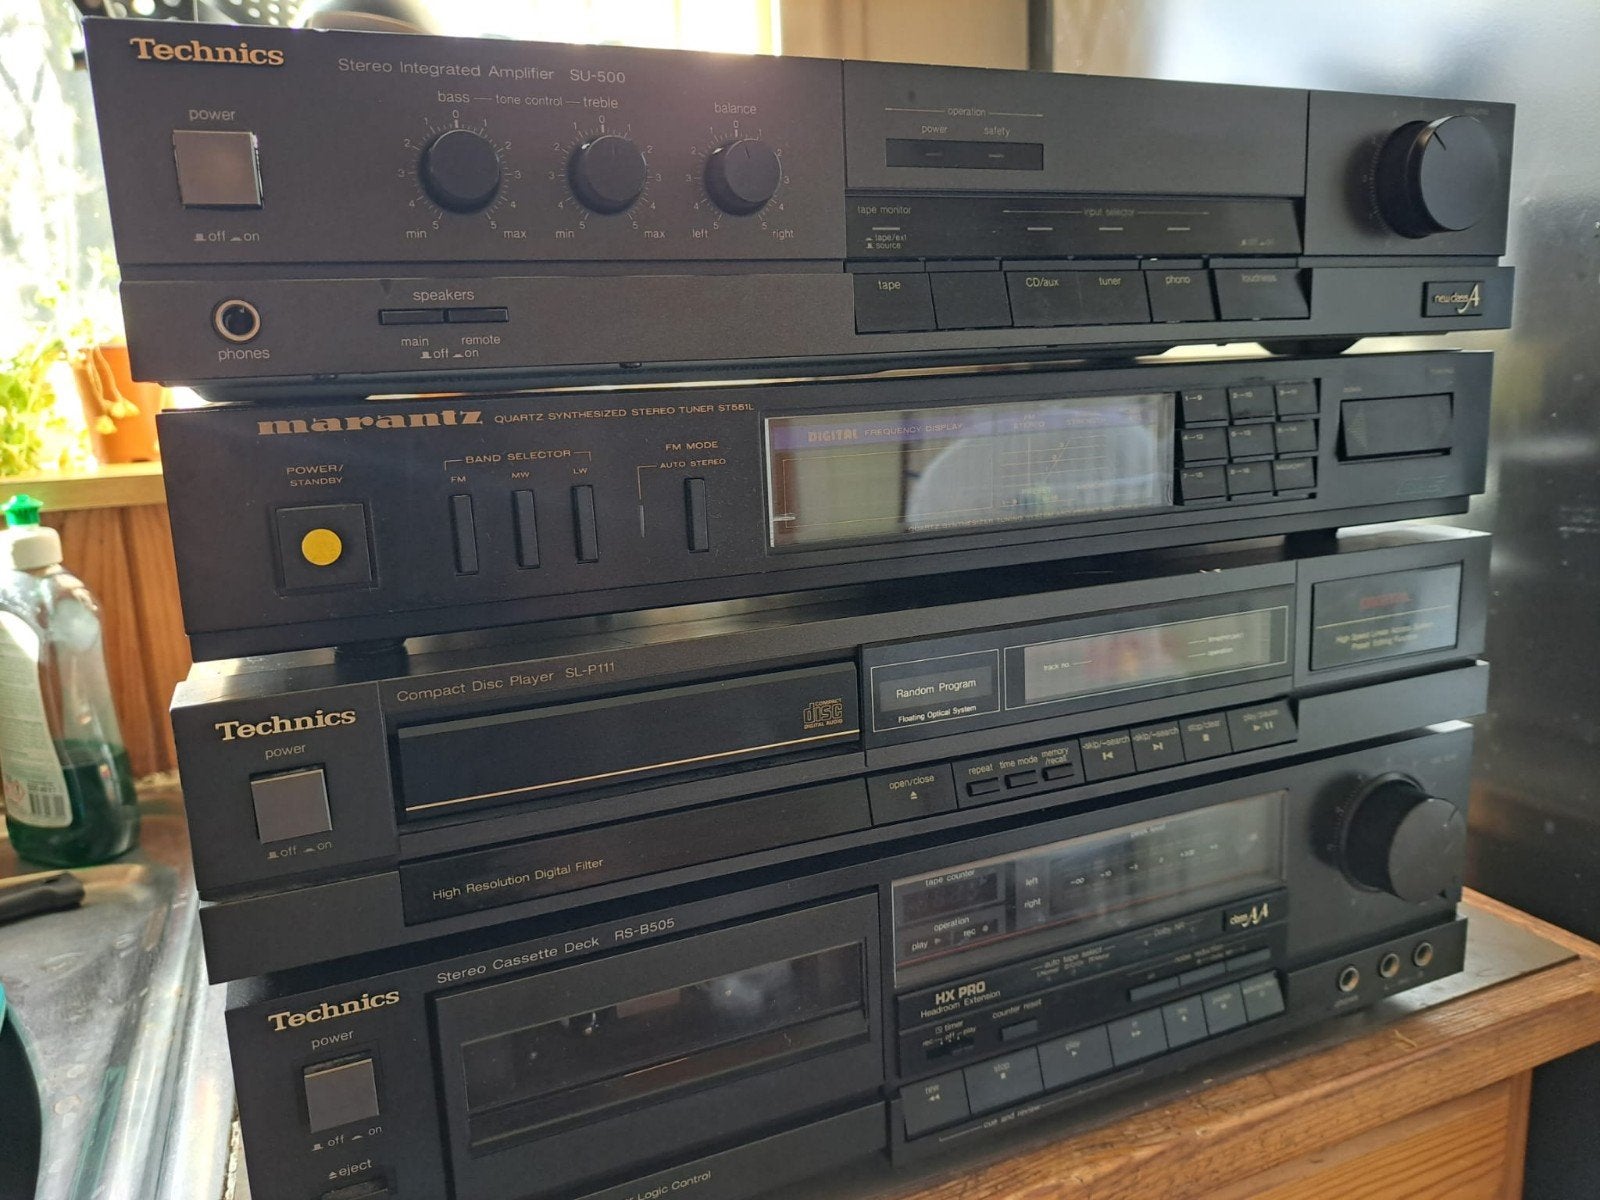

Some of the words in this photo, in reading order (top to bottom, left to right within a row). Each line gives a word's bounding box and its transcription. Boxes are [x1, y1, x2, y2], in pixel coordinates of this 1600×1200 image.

[130, 37, 285, 67] Technics
[338, 58, 393, 73] Stereo
[400, 61, 481, 78] Integrated
[489, 65, 554, 81] Amplifier
[570, 69, 626, 83] SU-500
[437, 90, 470, 104] bass
[496, 93, 521, 105] tone
[524, 95, 563, 107] control
[583, 96, 619, 109] treble
[714, 102, 757, 115] balance
[947, 107, 987, 118] operation
[188, 108, 236, 122] power
[921, 125, 949, 135] power
[984, 126, 1011, 137] safety
[857, 205, 877, 216] tape
[880, 205, 912, 215] monitor
[208, 230, 227, 242] off
[243, 231, 260, 242] on
[406, 228, 427, 239] min
[503, 229, 527, 239] max
[555, 229, 575, 239] min
[644, 230, 665, 239] max
[692, 229, 708, 239] left
[772, 229, 794, 240] right
[876, 241, 902, 249] source
[878, 280, 901, 291] tape
[1025, 277, 1060, 288] CD/aux
[1099, 276, 1121, 286] tuner
[1165, 275, 1191, 286] phono
[413, 289, 475, 302] speakers
[1457, 283, 1480, 314] A
[401, 336, 430, 347] main
[461, 334, 501, 346] remote
[218, 347, 270, 362] phones
[433, 349, 449, 359] off
[464, 349, 479, 358] on
[257, 409, 484, 436] marantz
[494, 413, 544, 424] QUARTZ
[548, 409, 627, 421] SYNTHESIZED
[631, 406, 675, 417] STEREO
[678, 404, 714, 414] TUNER
[808, 428, 858, 443] DIGITAL
[864, 425, 922, 438] FREQUENCY
[925, 422, 963, 433] DISPLAY
[666, 442, 682, 451] FM
[686, 440, 719, 450] MODE
[465, 454, 501, 464] BAND
[507, 450, 571, 461] SELECTOR
[660, 460, 686, 469] AUTO
[690, 458, 727, 467] STEREO
[286, 464, 344, 476] POWER/
[511, 471, 530, 479] MW
[573, 467, 588, 475] LW
[290, 477, 343, 487] STANDBY
[450, 475, 466, 483] FM
[397, 682, 466, 702] Compact
[472, 675, 504, 692] Disc
[510, 670, 554, 690] Player
[565, 661, 615, 679] SL-P111
[896, 683, 935, 700] Random
[939, 678, 977, 695] Program
[815, 698, 842, 707] COMPACT
[803, 702, 843, 724] disc
[898, 712, 925, 724] Floating
[927, 708, 951, 721] Optical
[953, 705, 977, 717] System
[214, 708, 357, 742] Technics
[803, 721, 825, 730] DIGITAL
[826, 718, 843, 726] AUDIO
[265, 742, 306, 760] power
[1042, 747, 1069, 758] memory
[999, 760, 1016, 769] time
[1017, 756, 1039, 767] mode
[968, 764, 994, 776] repeat
[889, 773, 935, 791] open/close
[280, 844, 297, 858] off
[317, 840, 332, 851] on
[432, 886, 462, 902] High
[466, 872, 531, 895] Resolution
[534, 863, 572, 885] Digital
[575, 857, 604, 875] Filter
[925, 876, 944, 888] tape
[947, 869, 976, 883] counter
[1025, 876, 1038, 887] left
[1024, 897, 1041, 909] right
[934, 915, 970, 932] operation
[963, 927, 976, 937] rec
[436, 962, 487, 985] Stereo
[492, 945, 558, 972] Cassette
[564, 934, 600, 955] Deck
[614, 917, 676, 941] RS-B505
[935, 989, 956, 1005] HX
[958, 981, 986, 999] PRO
[268, 988, 401, 1032] Technics
[921, 1000, 961, 1018] Headroom
[964, 990, 1001, 1006] Extension
[992, 1005, 1021, 1019] counter
[1023, 998, 1042, 1010] reset
[944, 1020, 964, 1031] timer
[311, 1029, 354, 1050] power
[368, 1125, 383, 1136] on
[327, 1134, 345, 1147] off
[338, 1158, 373, 1179] eject
[637, 1185, 669, 1200] Logic
[671, 1170, 712, 1191] Control
